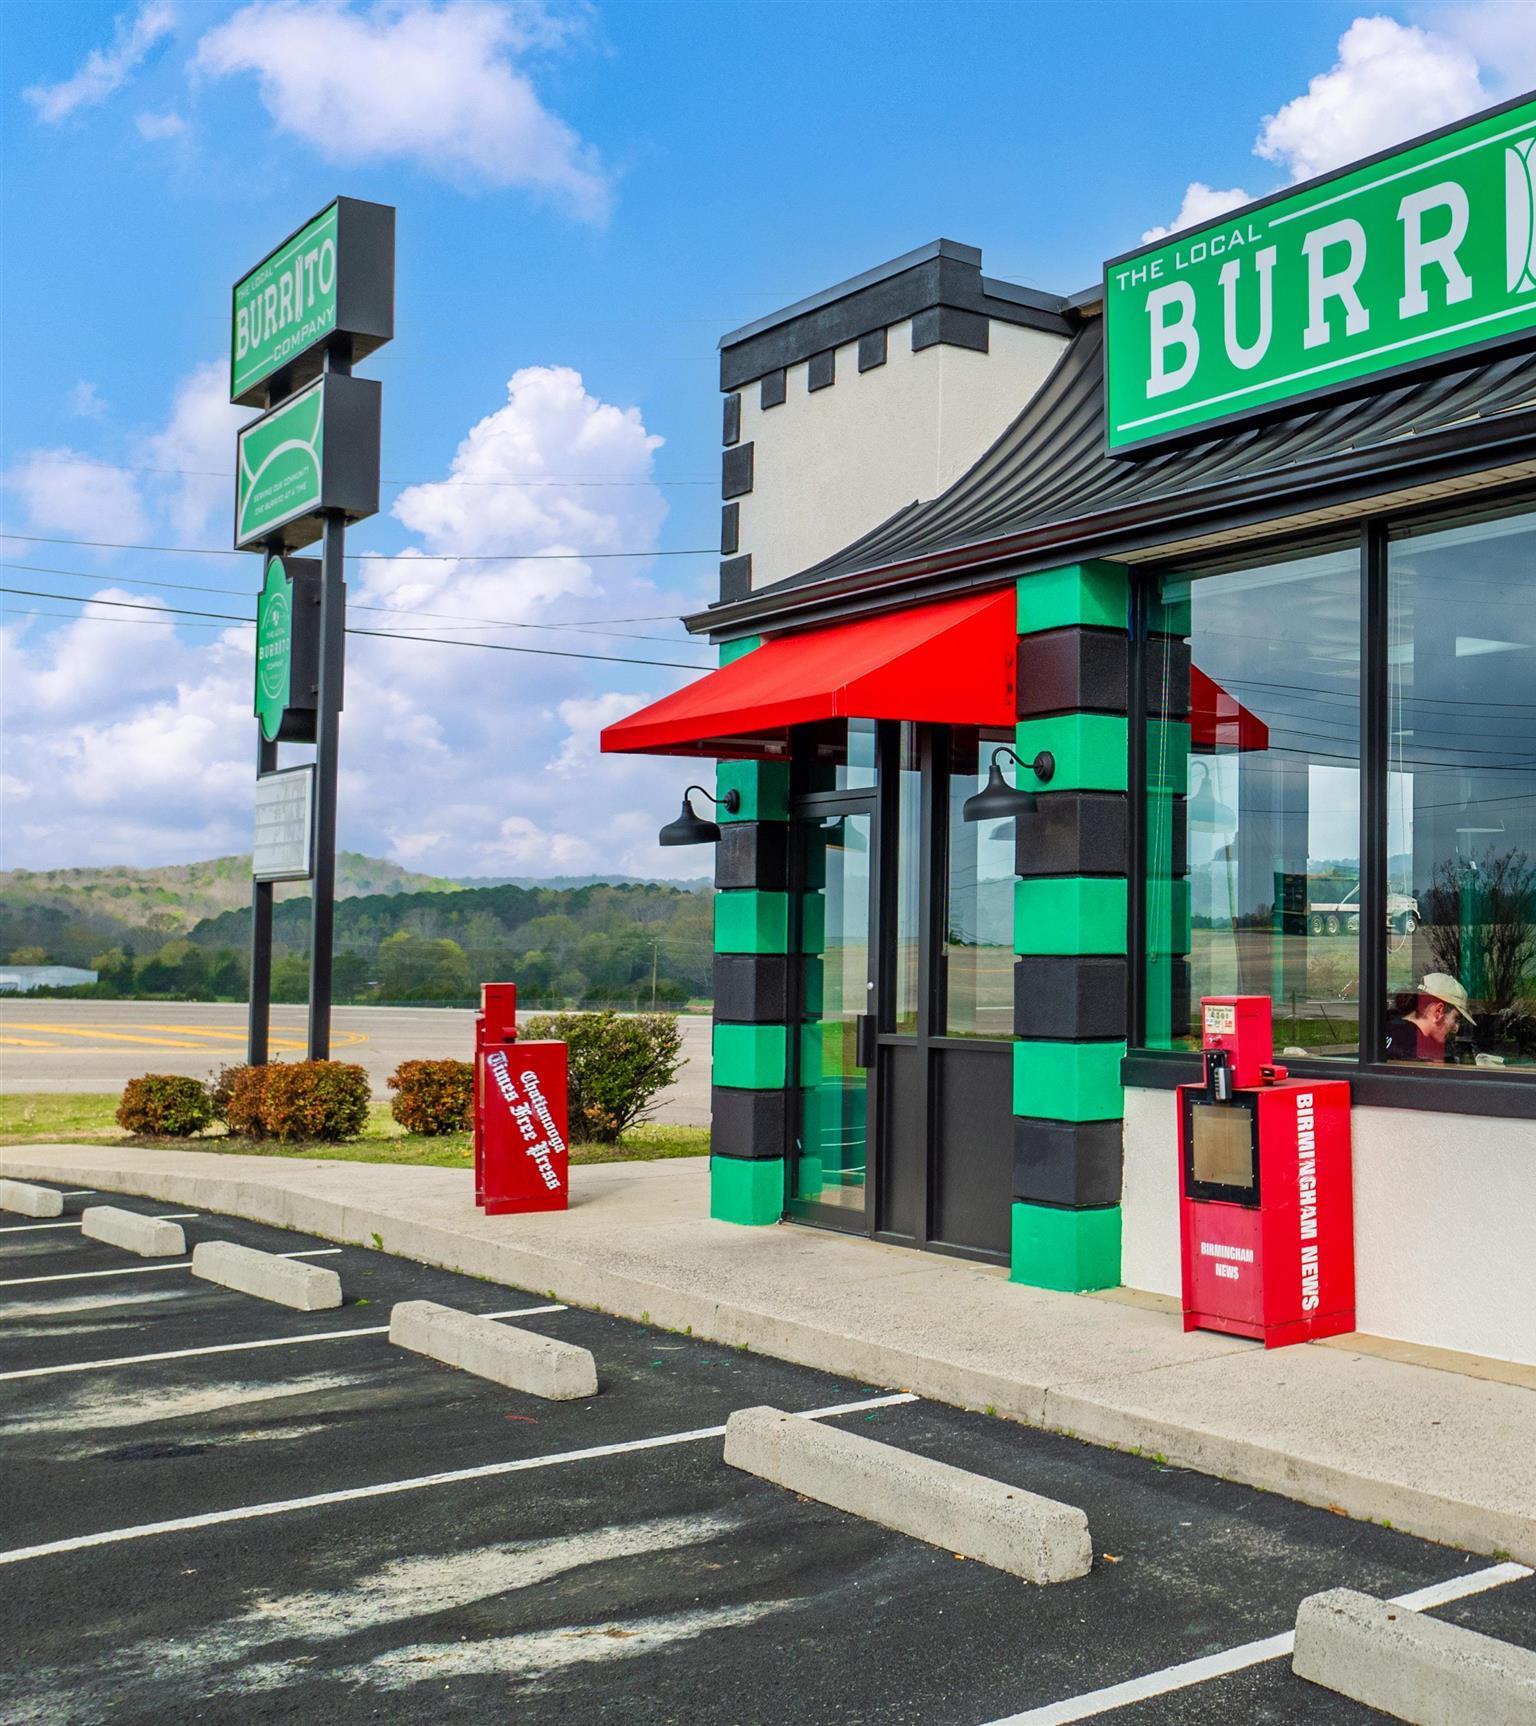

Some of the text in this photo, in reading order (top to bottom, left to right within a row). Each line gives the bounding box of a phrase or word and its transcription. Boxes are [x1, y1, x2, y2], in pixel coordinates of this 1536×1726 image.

[1116, 224, 1262, 291] THE LOCAL
[236, 238, 336, 362] BURRITO
[273, 304, 336, 362] COMPANY
[487, 1050, 561, 1190] Times Free Press
[520, 1070, 566, 1153] Chattanooga
[1296, 1093, 1319, 1311] BIRMINGHAM NEWS
[1200, 1241, 1254, 1263] BIRMINGHAM
[1215, 1262, 1240, 1280] NEWS
